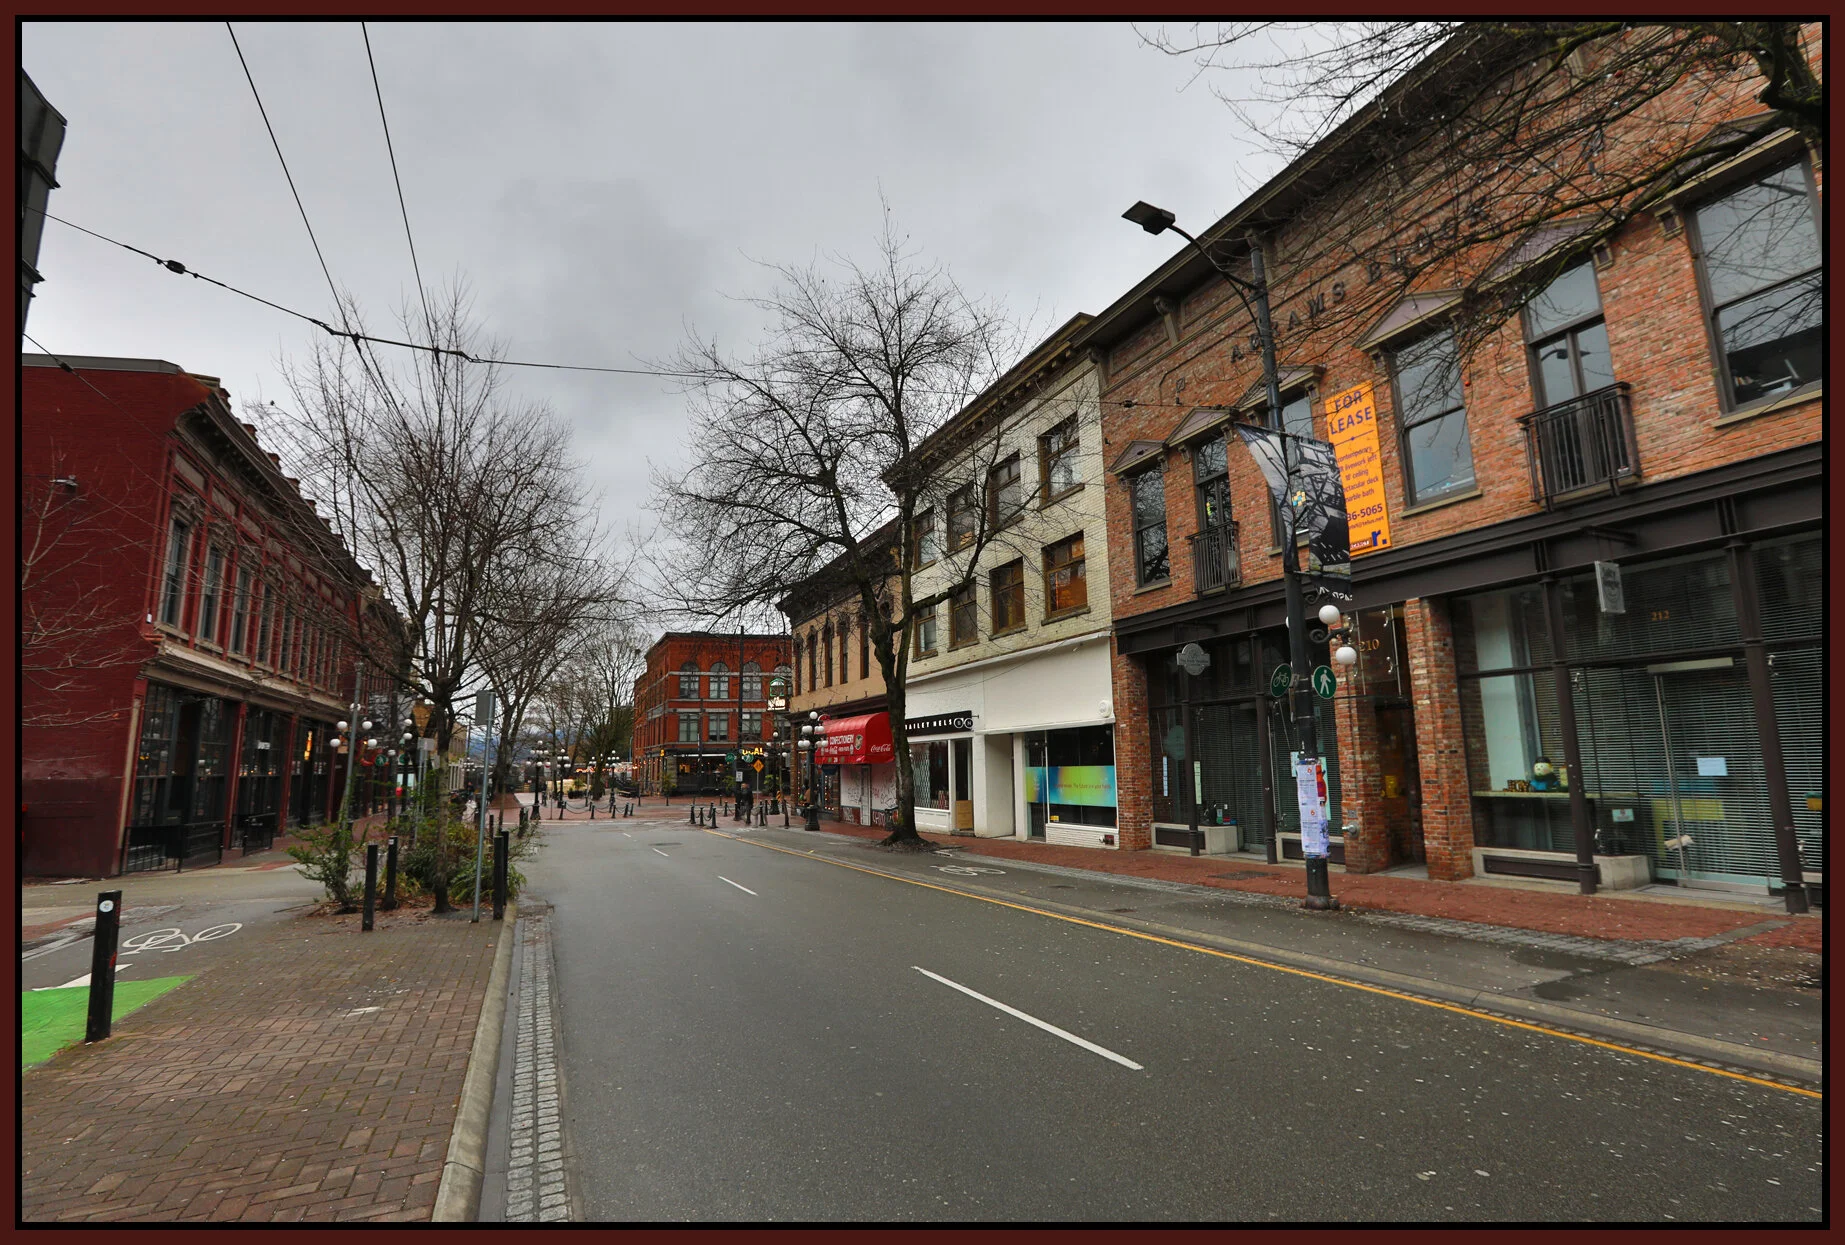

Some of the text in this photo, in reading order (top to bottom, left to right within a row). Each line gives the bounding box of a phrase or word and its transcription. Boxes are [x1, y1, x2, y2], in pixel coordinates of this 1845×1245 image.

[1334, 390, 1363, 412] FOR
[1329, 405, 1373, 435] LEASE
[1650, 609, 1670, 622] 212
[1359, 638, 1380, 652] 210
